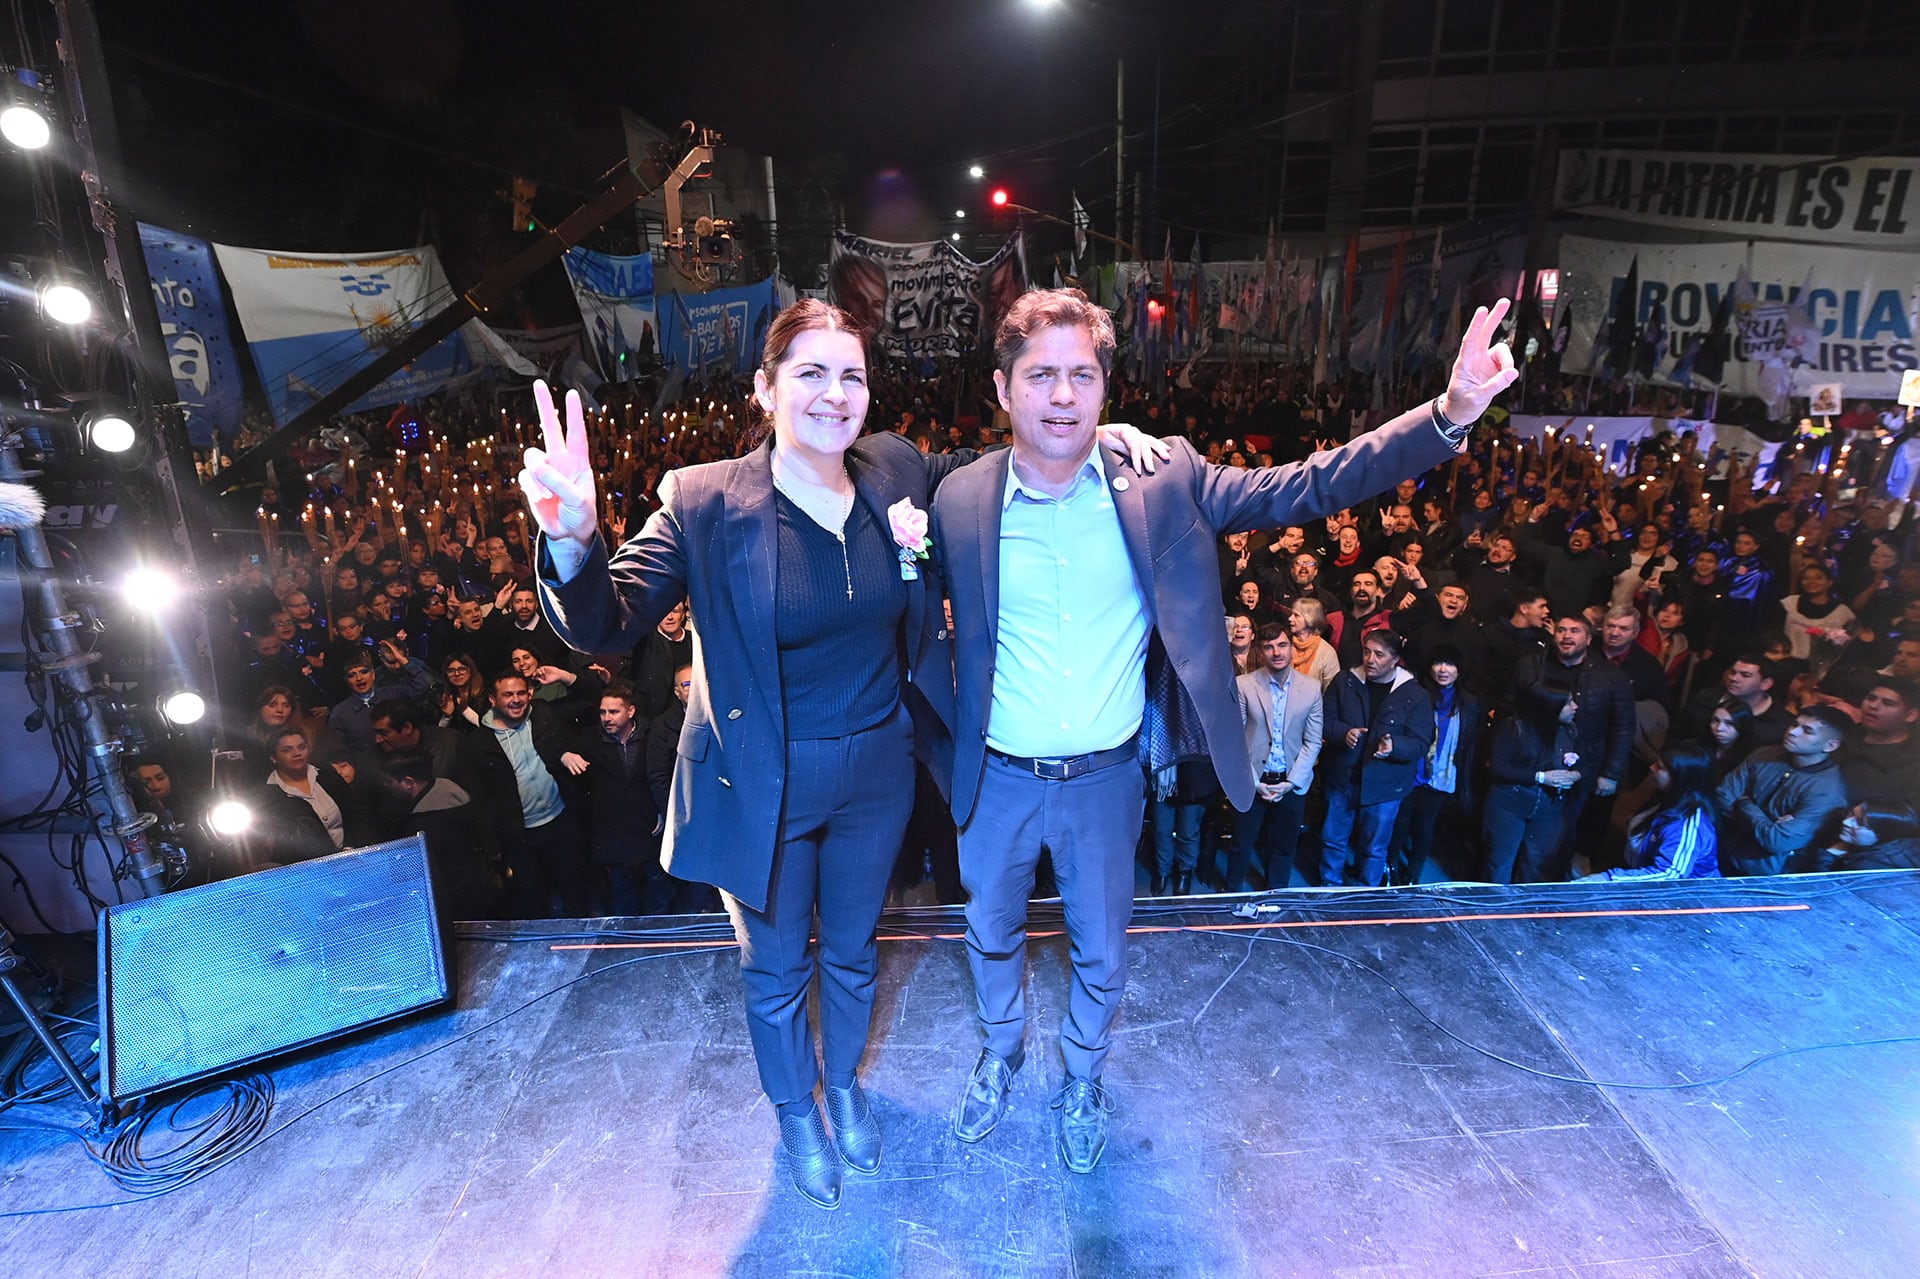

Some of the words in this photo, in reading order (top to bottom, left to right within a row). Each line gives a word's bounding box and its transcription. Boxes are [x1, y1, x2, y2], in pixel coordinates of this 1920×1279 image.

[1594, 157, 1632, 211] LA
[1638, 160, 1780, 224] PATRIA
[1785, 164, 1849, 230] ES
[1853, 168, 1913, 234] EL
